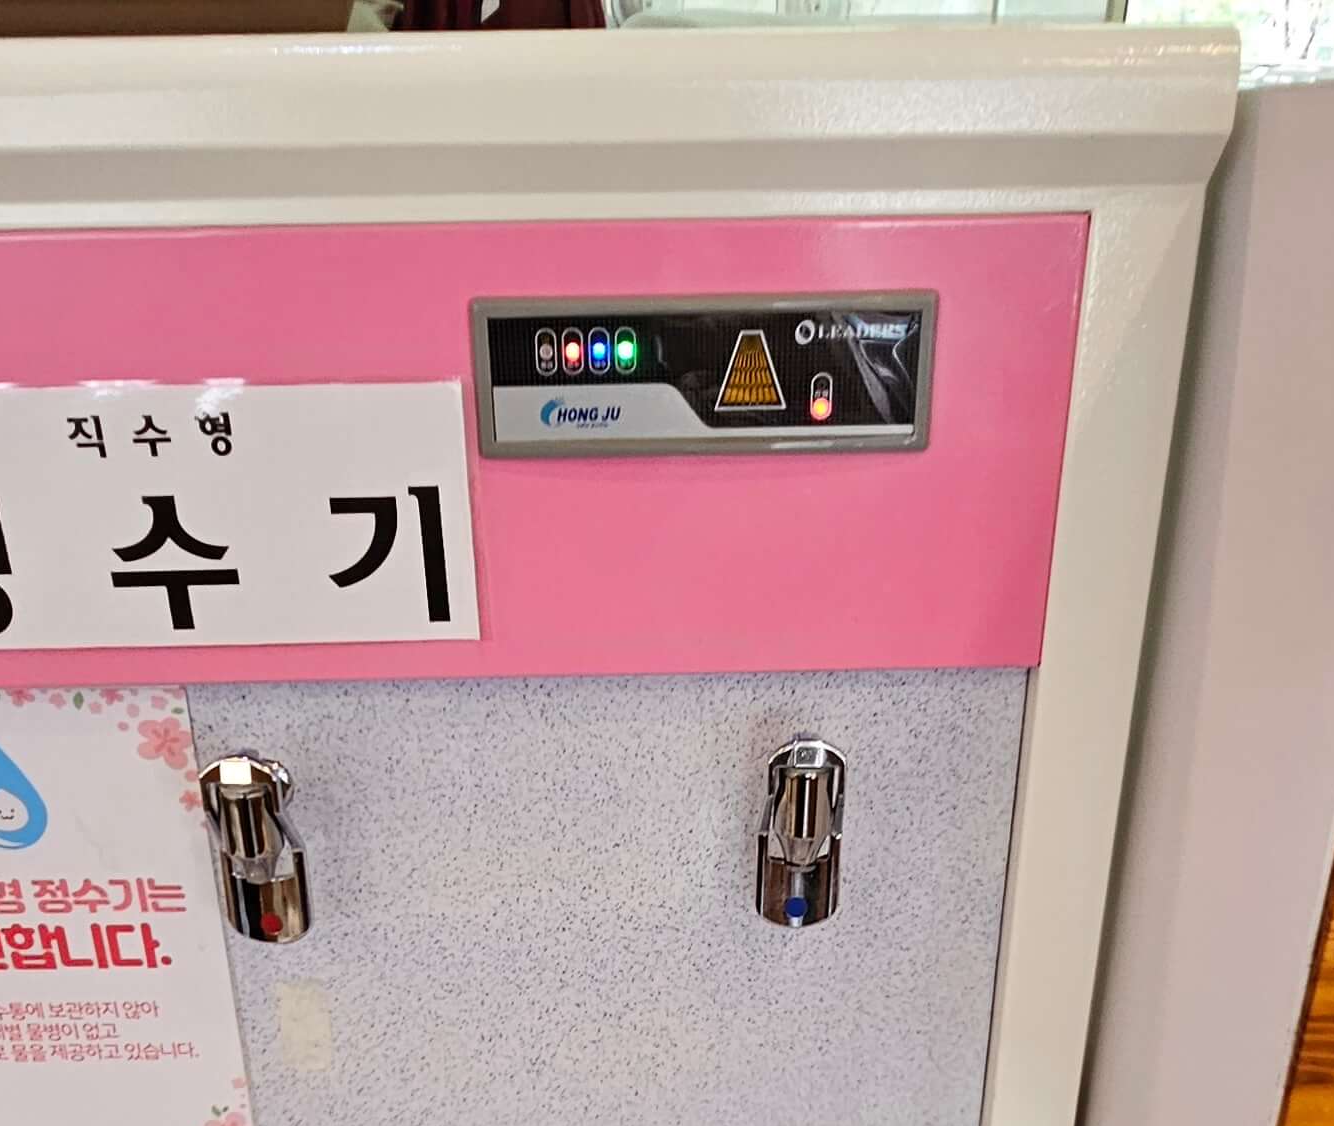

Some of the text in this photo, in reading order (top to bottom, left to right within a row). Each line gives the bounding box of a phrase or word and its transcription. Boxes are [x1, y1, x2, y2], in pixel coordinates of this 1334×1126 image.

[557, 406, 622, 423] HONG JU
[31, 878, 187, 914] 정수기는
[48, 1001, 120, 1020] 보관하지
[122, 1000, 159, 1020] 않아
[26, 1023, 79, 1041] 물병이
[82, 1022, 119, 1041] 없고
[12, 1043, 46, 1062] 물을
[49, 1042, 122, 1061] 제공하고
[124, 1041, 200, 1061] 있습니다.
